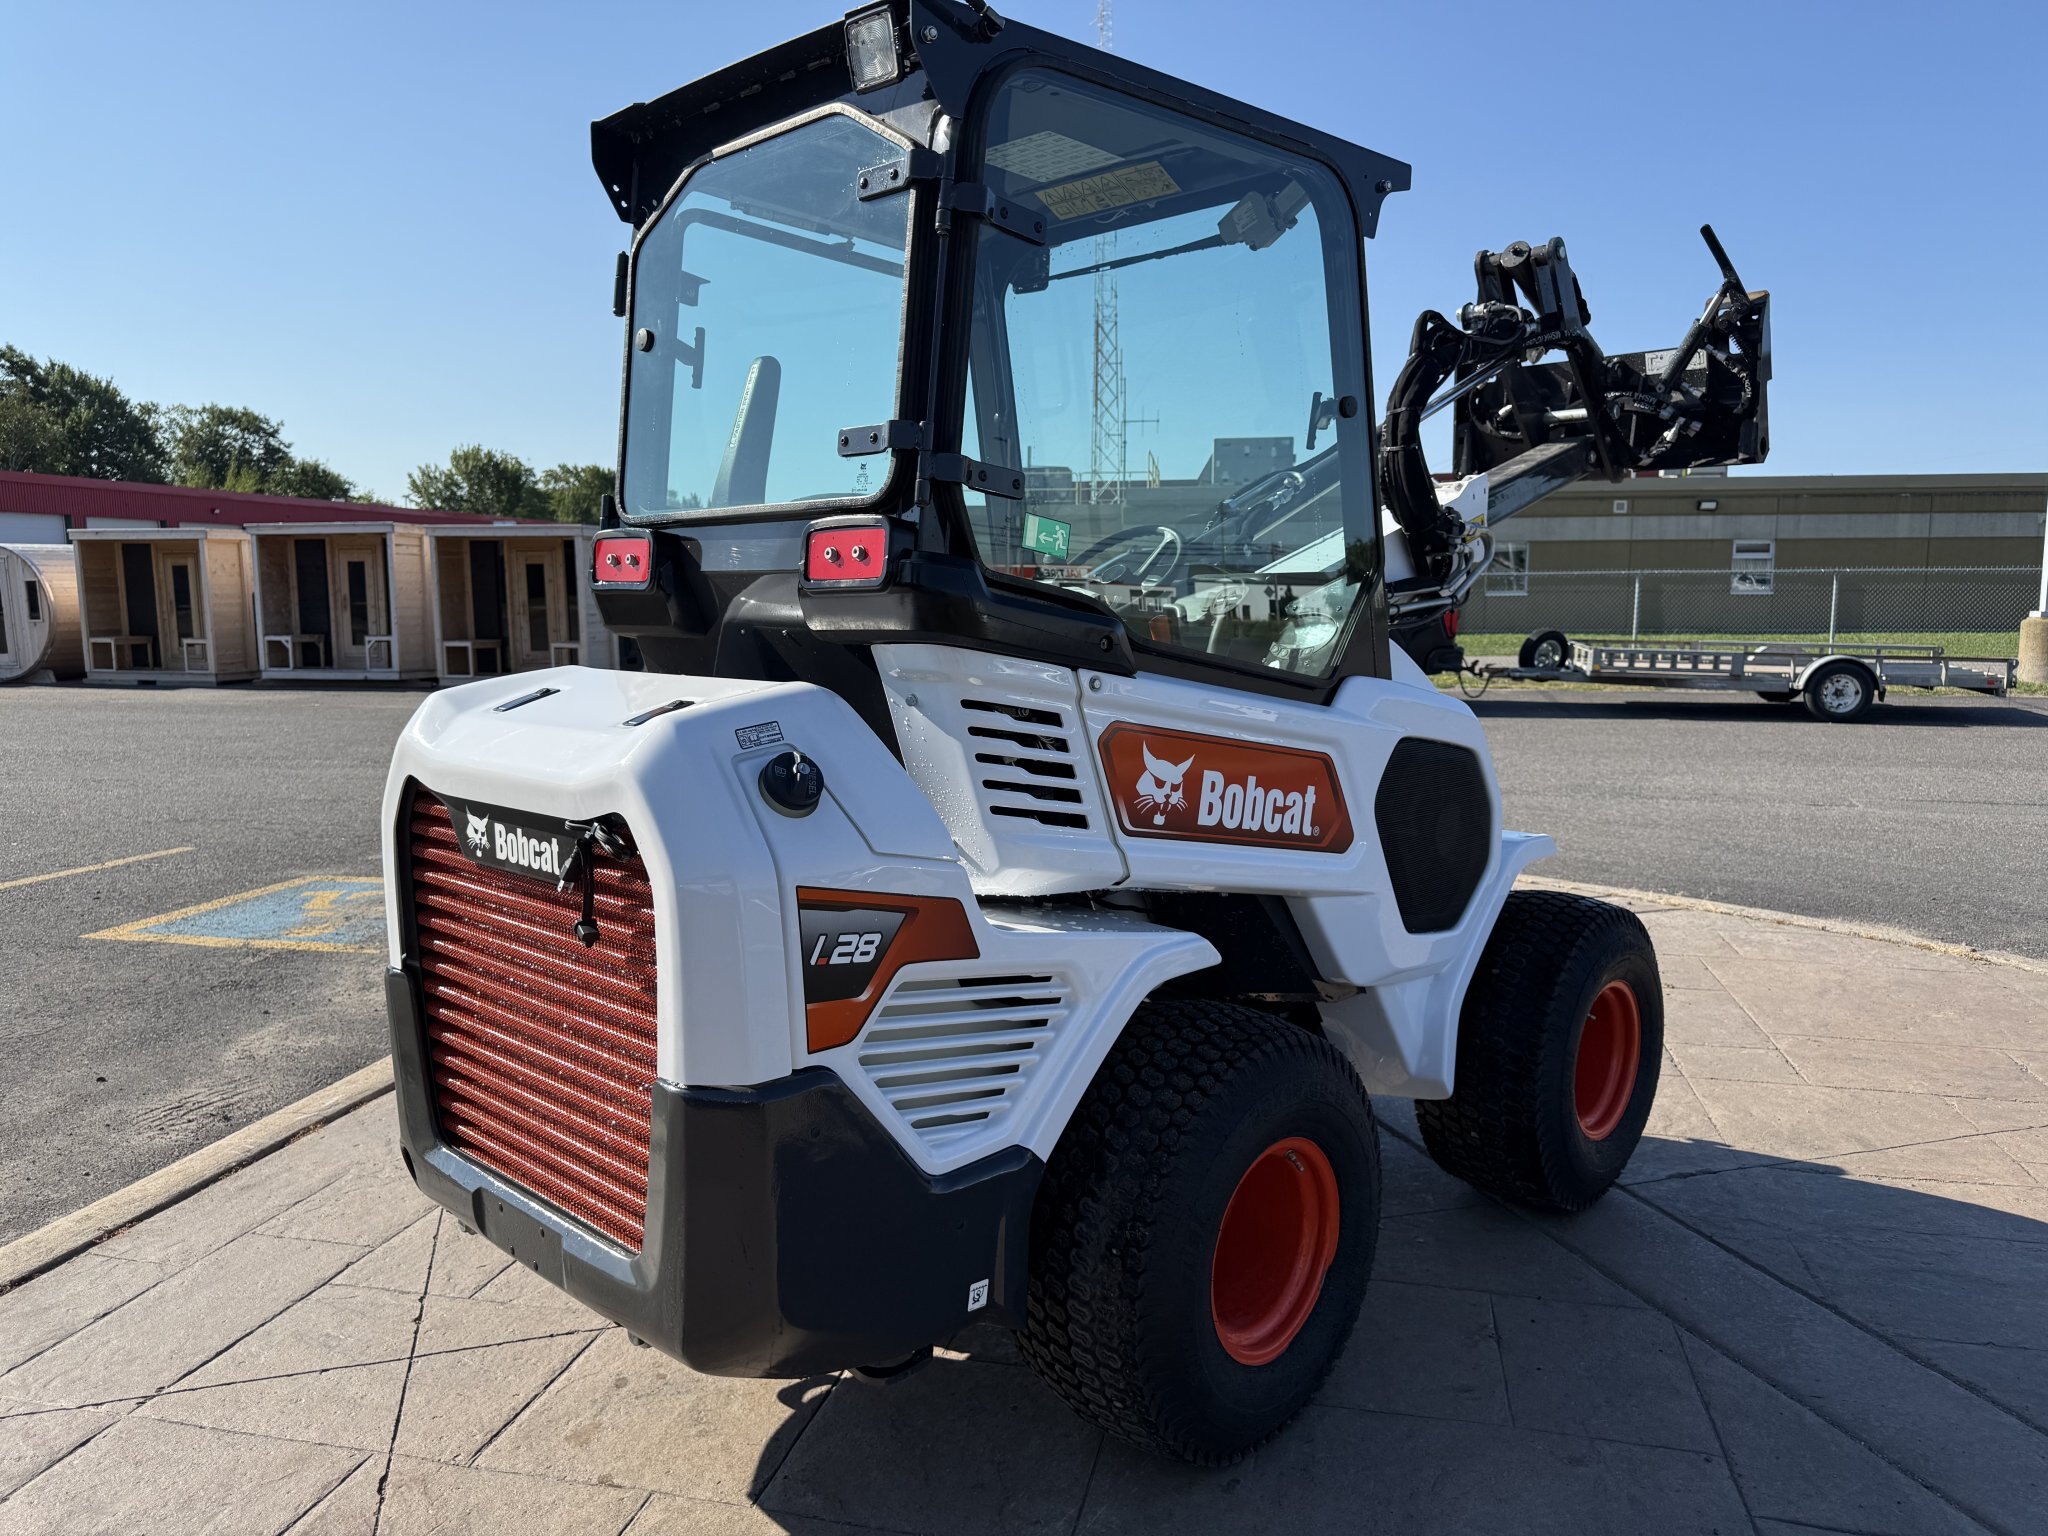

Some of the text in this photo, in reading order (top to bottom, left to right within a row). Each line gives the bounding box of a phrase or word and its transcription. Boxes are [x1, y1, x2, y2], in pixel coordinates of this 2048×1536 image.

[807, 766, 817, 795] DIESEL
[1197, 769, 1316, 836] Bobcat
[494, 822, 561, 876] Bobcat
